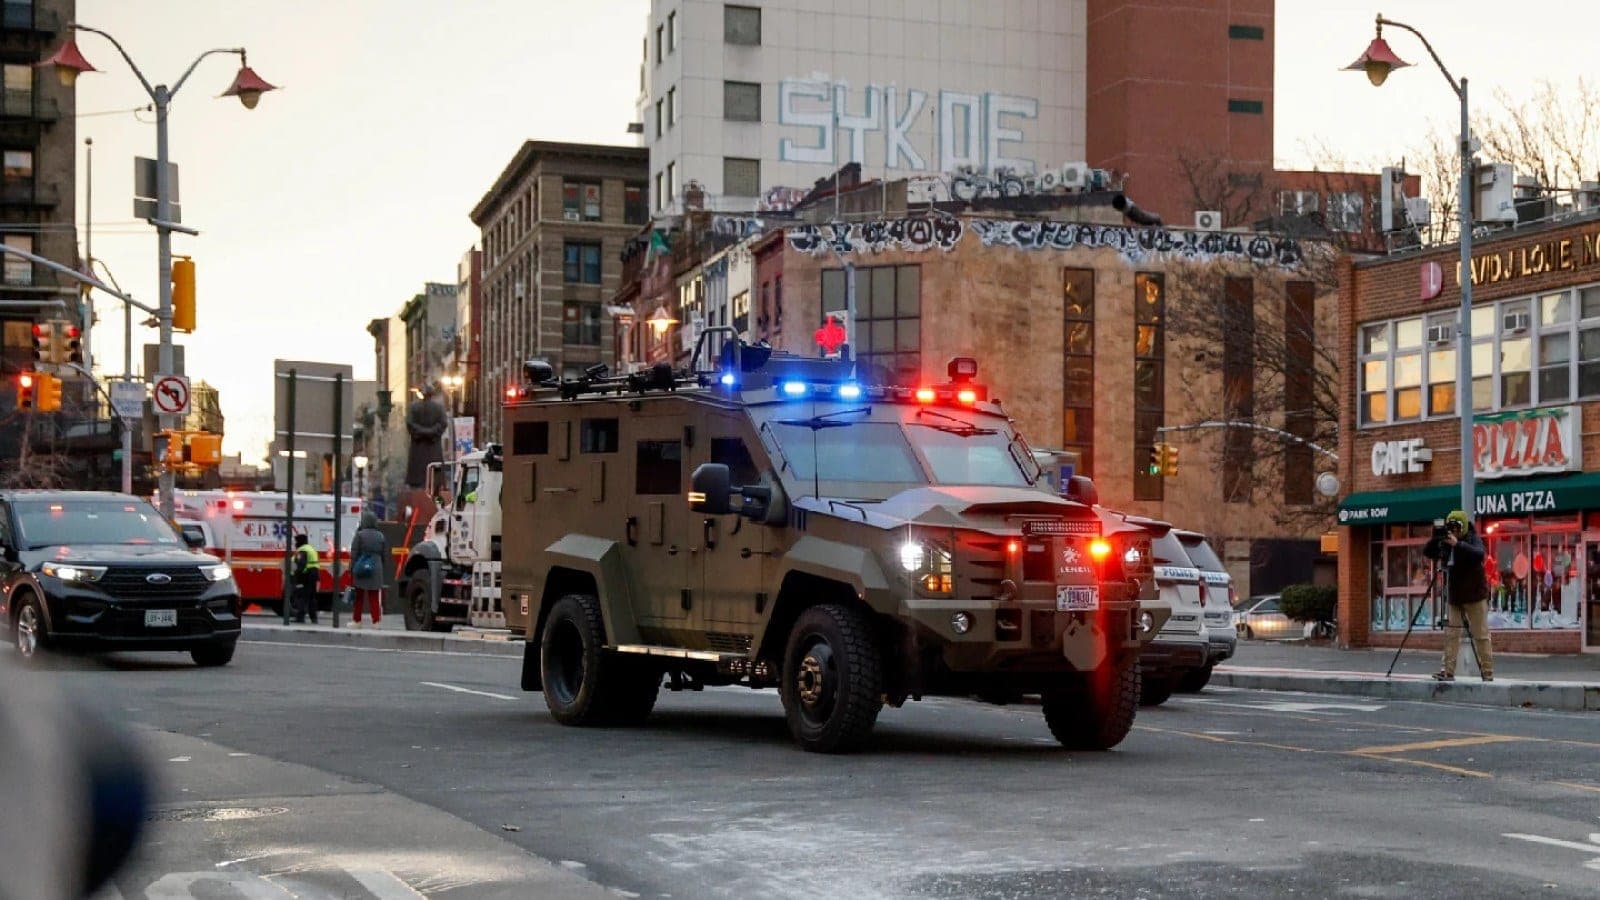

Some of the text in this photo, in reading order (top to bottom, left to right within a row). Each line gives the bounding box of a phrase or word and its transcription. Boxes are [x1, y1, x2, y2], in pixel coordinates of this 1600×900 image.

[1372, 439, 1424, 476] CAFE
[1473, 417, 1565, 471] PIZZA
[1474, 490, 1556, 514] UNA PIZZA
